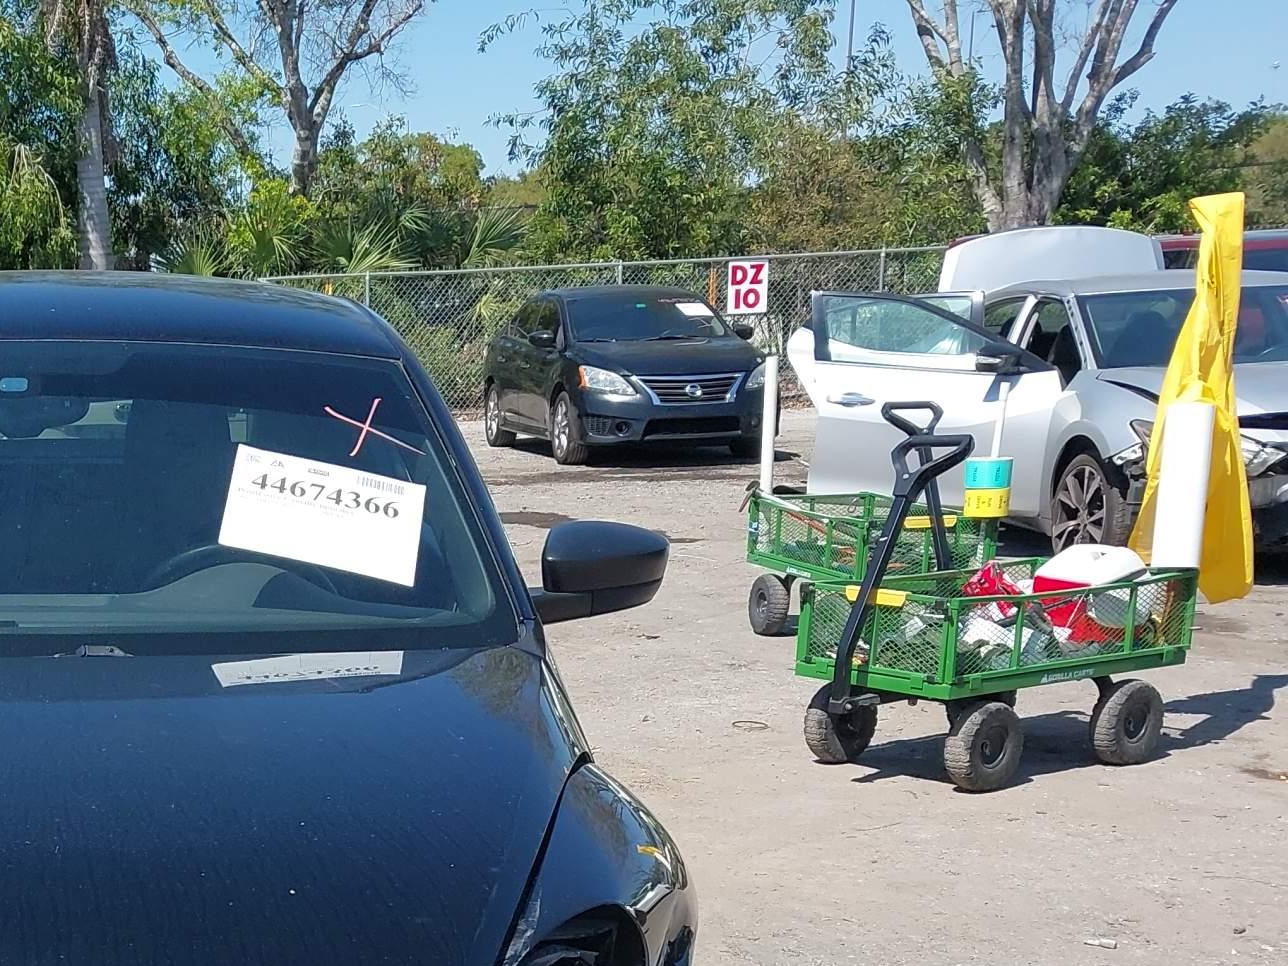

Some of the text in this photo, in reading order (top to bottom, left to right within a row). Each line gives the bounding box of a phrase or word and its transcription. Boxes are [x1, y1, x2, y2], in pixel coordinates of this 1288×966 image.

[731, 264, 765, 286] DZ
[734, 288, 760, 309] 10
[251, 473, 400, 519] 44674366
